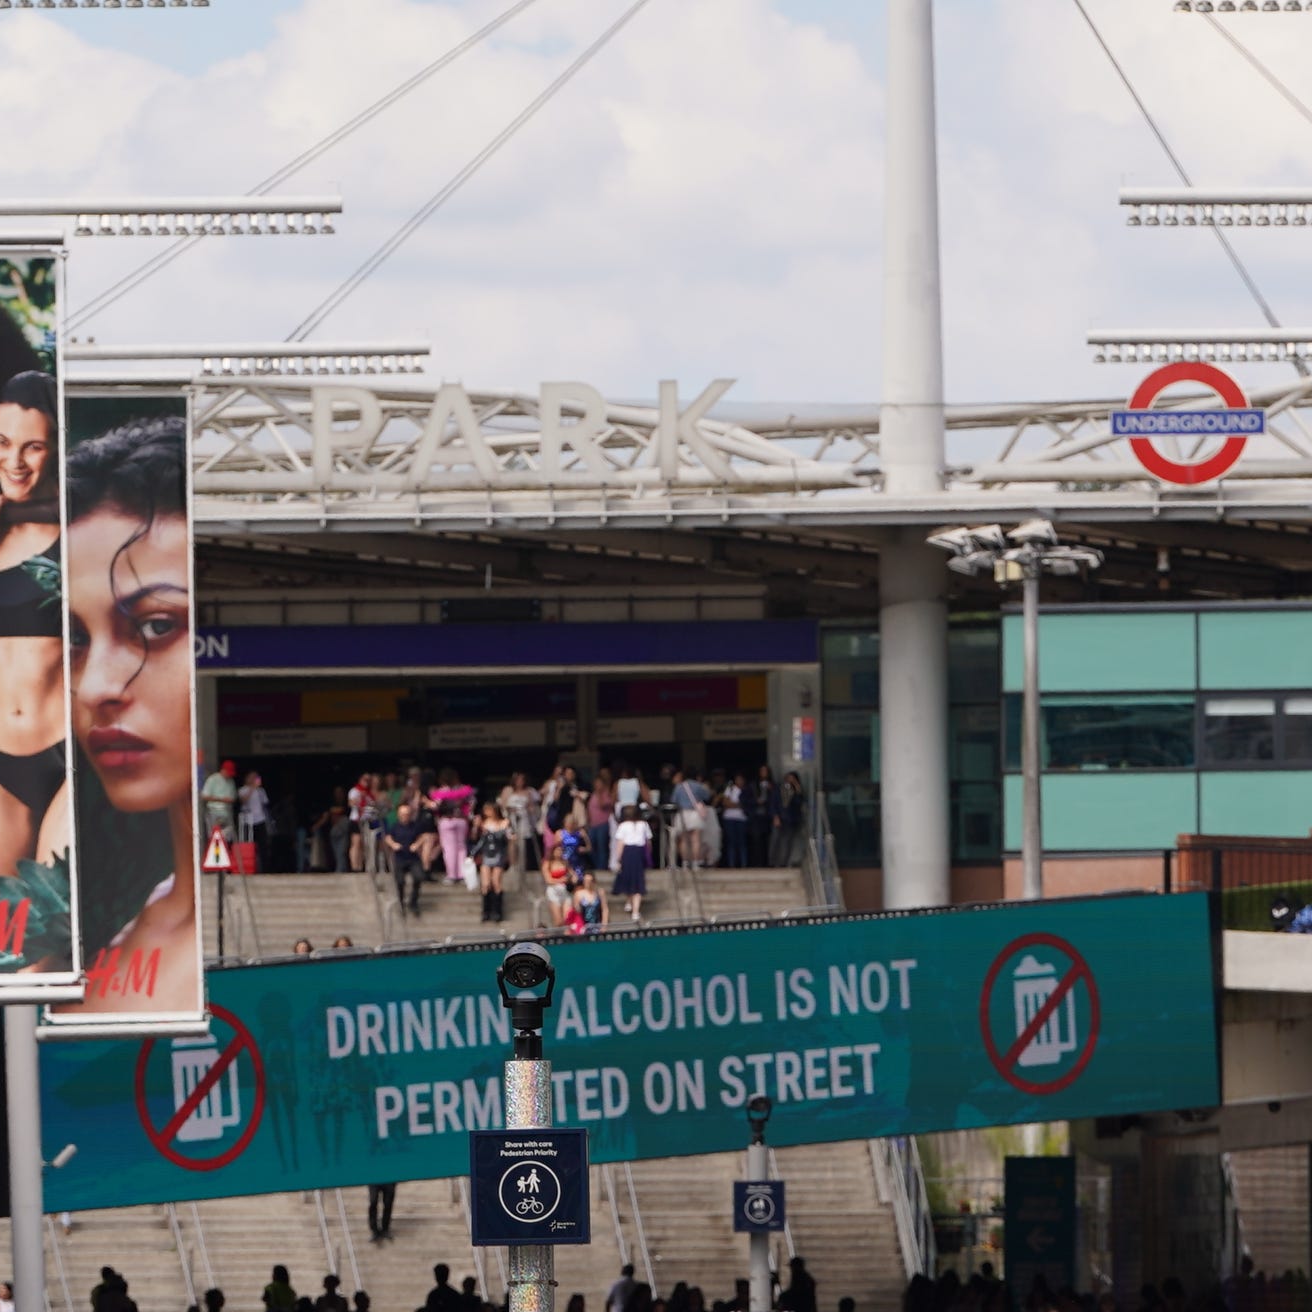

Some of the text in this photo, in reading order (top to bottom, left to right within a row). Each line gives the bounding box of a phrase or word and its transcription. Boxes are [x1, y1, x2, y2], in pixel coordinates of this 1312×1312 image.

[310, 378, 738, 486] PARK
[1116, 413, 1261, 432] UNDERGROUND
[84, 944, 161, 999] H&M
[327, 959, 917, 1059] DRINKIN ALCOHOL IS NOT
[643, 1059, 706, 1114] ON
[718, 1044, 881, 1107] STREET
